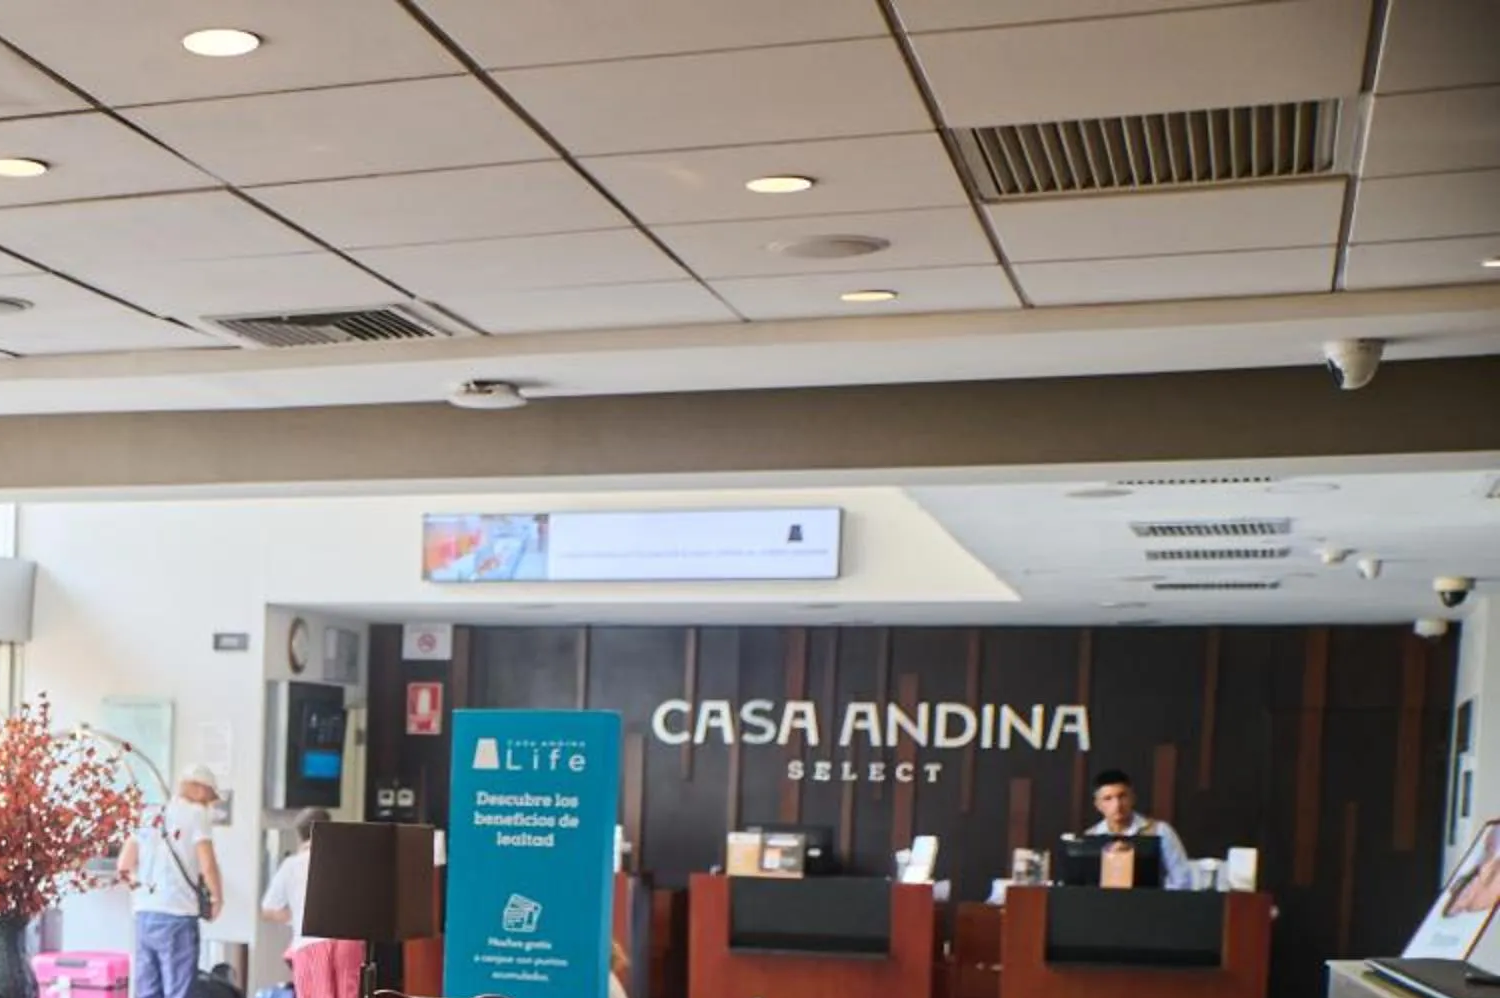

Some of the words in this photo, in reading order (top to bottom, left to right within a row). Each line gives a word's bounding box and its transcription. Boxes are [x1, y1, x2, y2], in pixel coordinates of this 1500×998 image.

[651, 698, 820, 747] CASA
[839, 701, 1092, 752] ANDINA
[505, 747, 587, 772] Life
[787, 760, 945, 784] SELECT
[475, 790, 553, 807] Descubre
[554, 793, 580, 808] los
[473, 811, 556, 828] beneficios
[557, 812, 580, 829] de
[496, 831, 555, 847] lealtad
